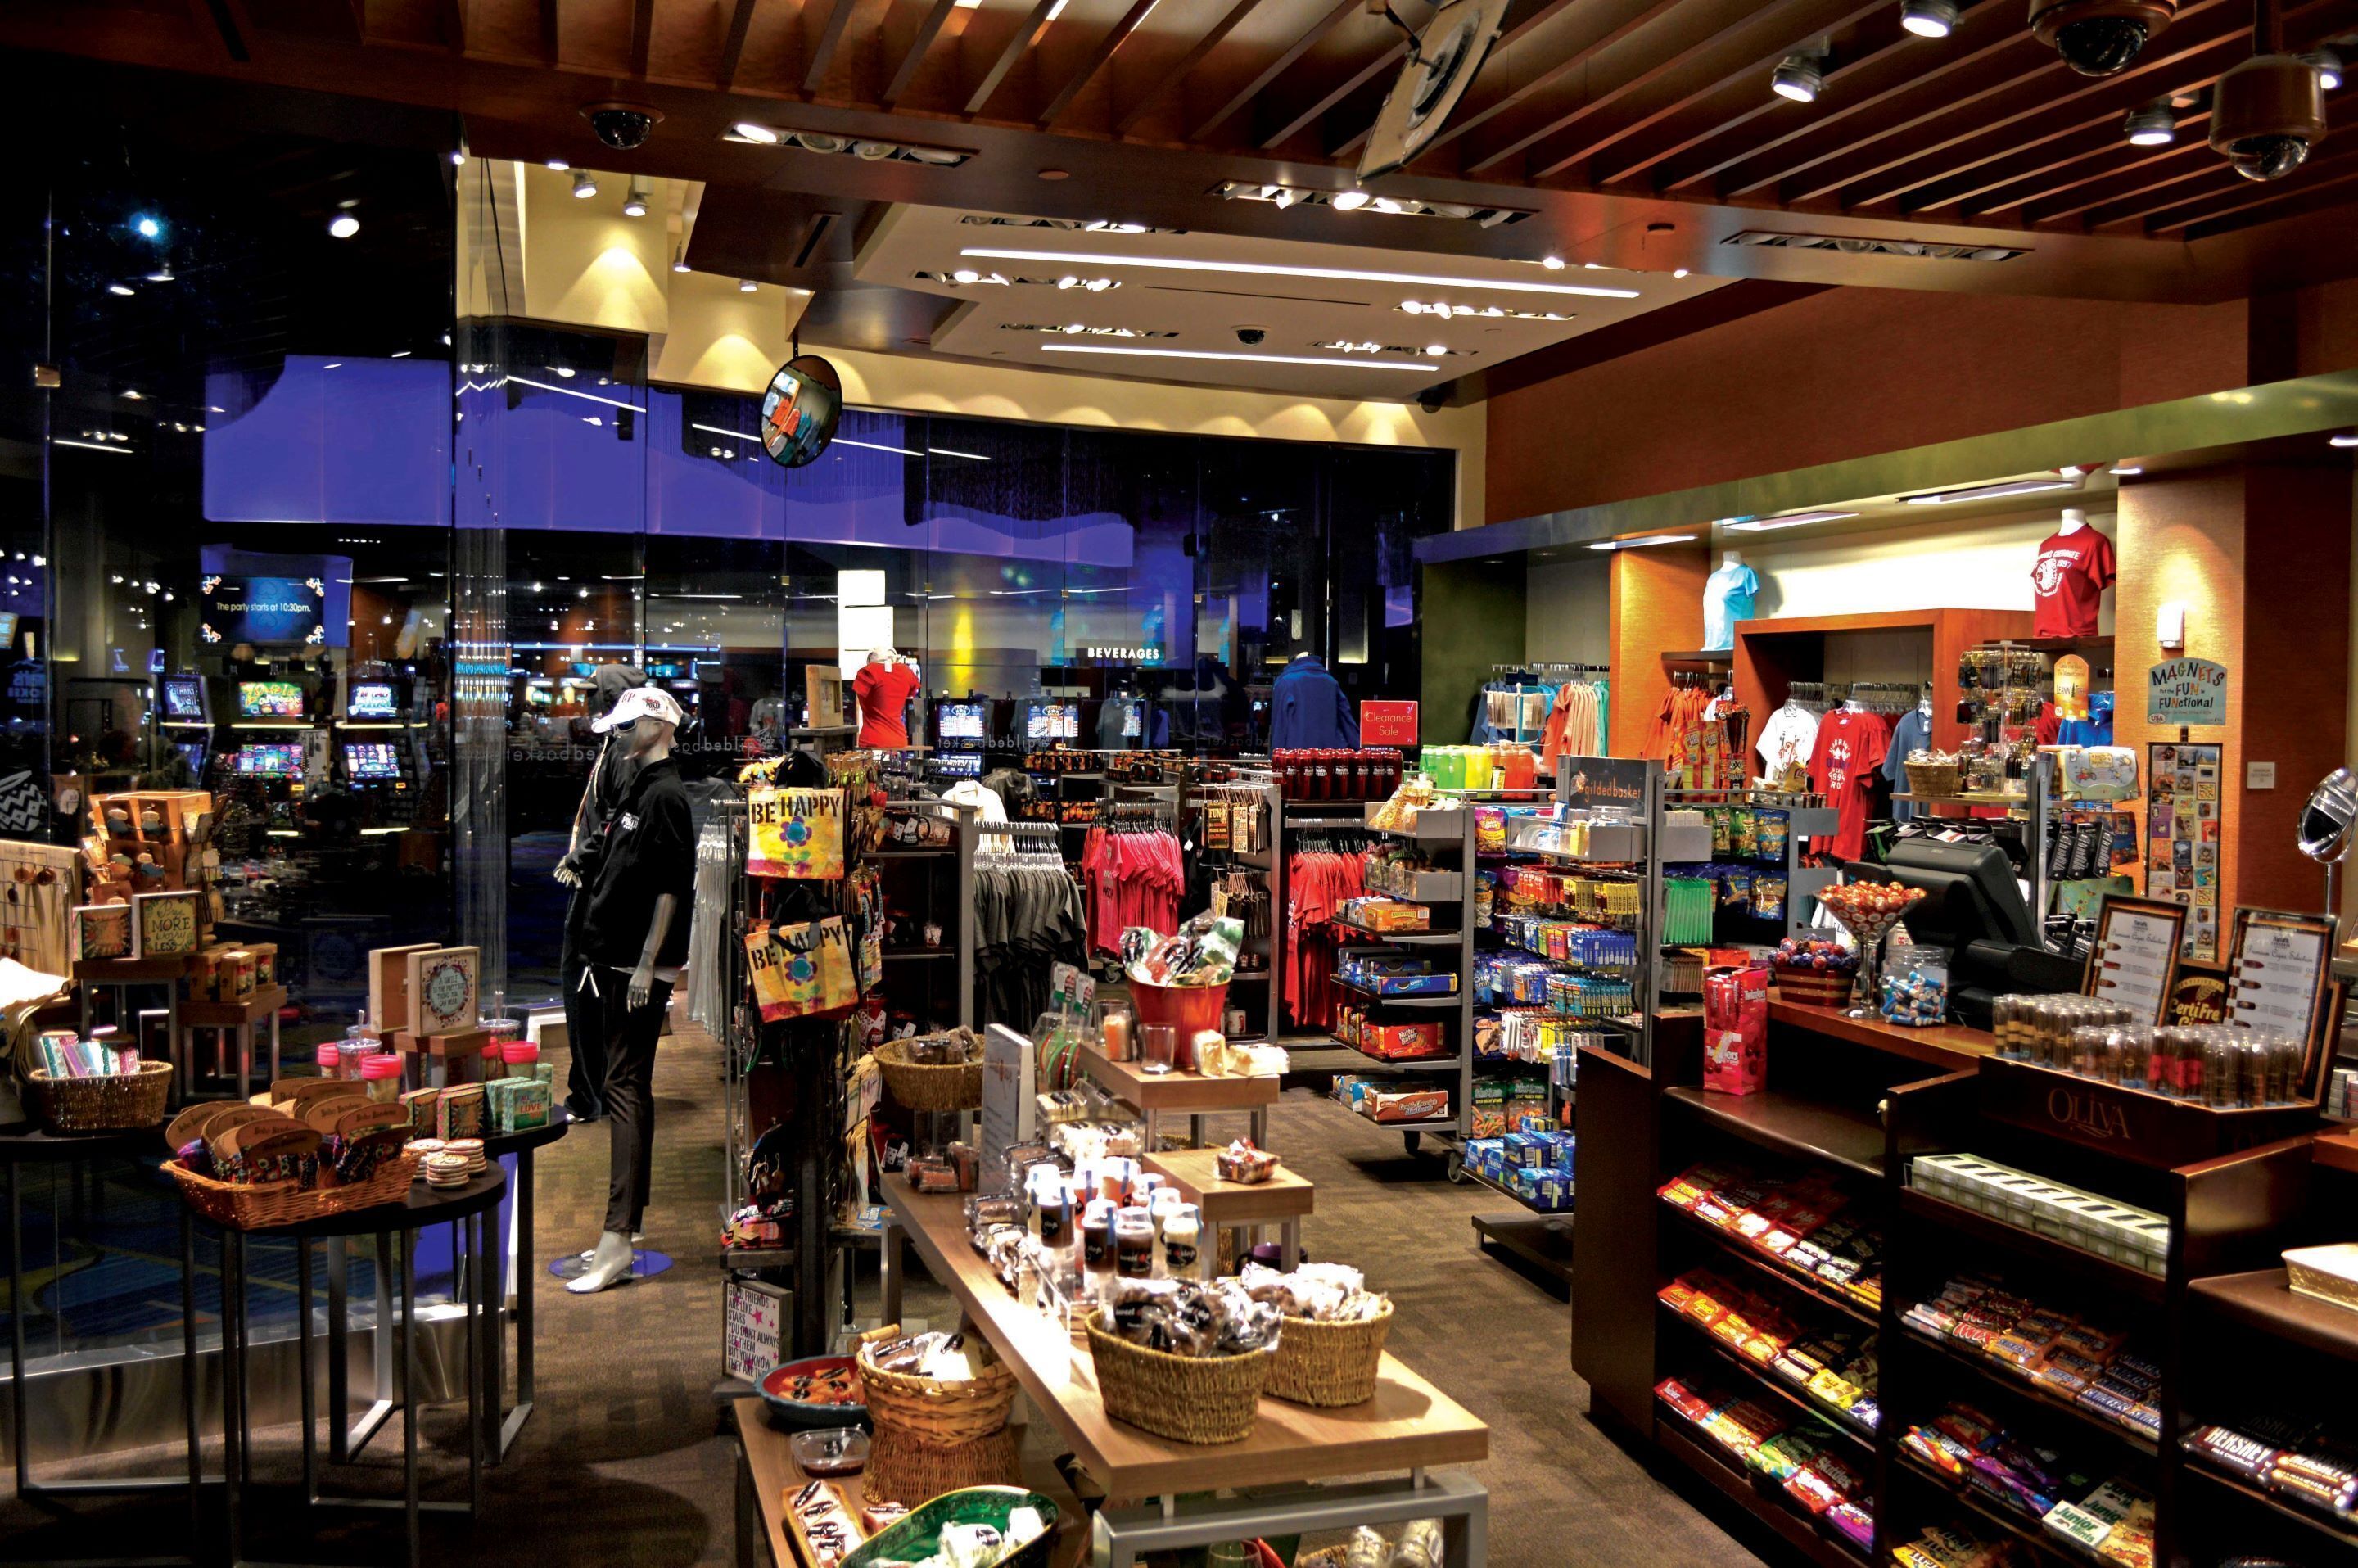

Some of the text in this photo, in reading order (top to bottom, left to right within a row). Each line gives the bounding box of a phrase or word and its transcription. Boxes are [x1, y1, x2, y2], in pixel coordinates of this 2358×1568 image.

[216, 603, 311, 612] The party starts at 10:30pm.
[1087, 647, 1159, 660] BEVERAGES
[2152, 662, 2225, 686] MAGNETS
[2175, 682, 2199, 696] FUN
[2158, 696, 2214, 709] FUNctional
[1366, 711, 1412, 722] Clearance
[1379, 726, 1398, 736] Sale
[1584, 777, 1642, 802] gildedbasket
[751, 794, 841, 824] BE HAPPY
[152, 917, 191, 933] MORE
[155, 942, 178, 952] LESS
[751, 944, 778, 970] BE
[2272, 951, 2287, 960] Cigar
[2172, 998, 2220, 1021] CertiFre
[1398, 1028, 1416, 1039] Nutter
[1401, 1033, 1418, 1045] Butter
[520, 1103, 542, 1114] LOVE
[728, 1285, 770, 1308] GOOD FRIENDS
[728, 1299, 752, 1315] ARE LIKE
[728, 1309, 746, 1324] STARS
[728, 1322, 739, 1335] YOU
[757, 1331, 779, 1349] ALWAYS
[740, 1337, 755, 1353] THEM
[728, 1346, 771, 1370] BUT YOU KNOW
[728, 1358, 742, 1371] THEY
[743, 1361, 754, 1376] ARE
[2224, 1452, 2256, 1468] CHOCOLATE
[1815, 1457, 1852, 1490] Skittles
[2054, 1507, 2098, 1531] Junior
[2068, 1524, 2096, 1543] Mints
